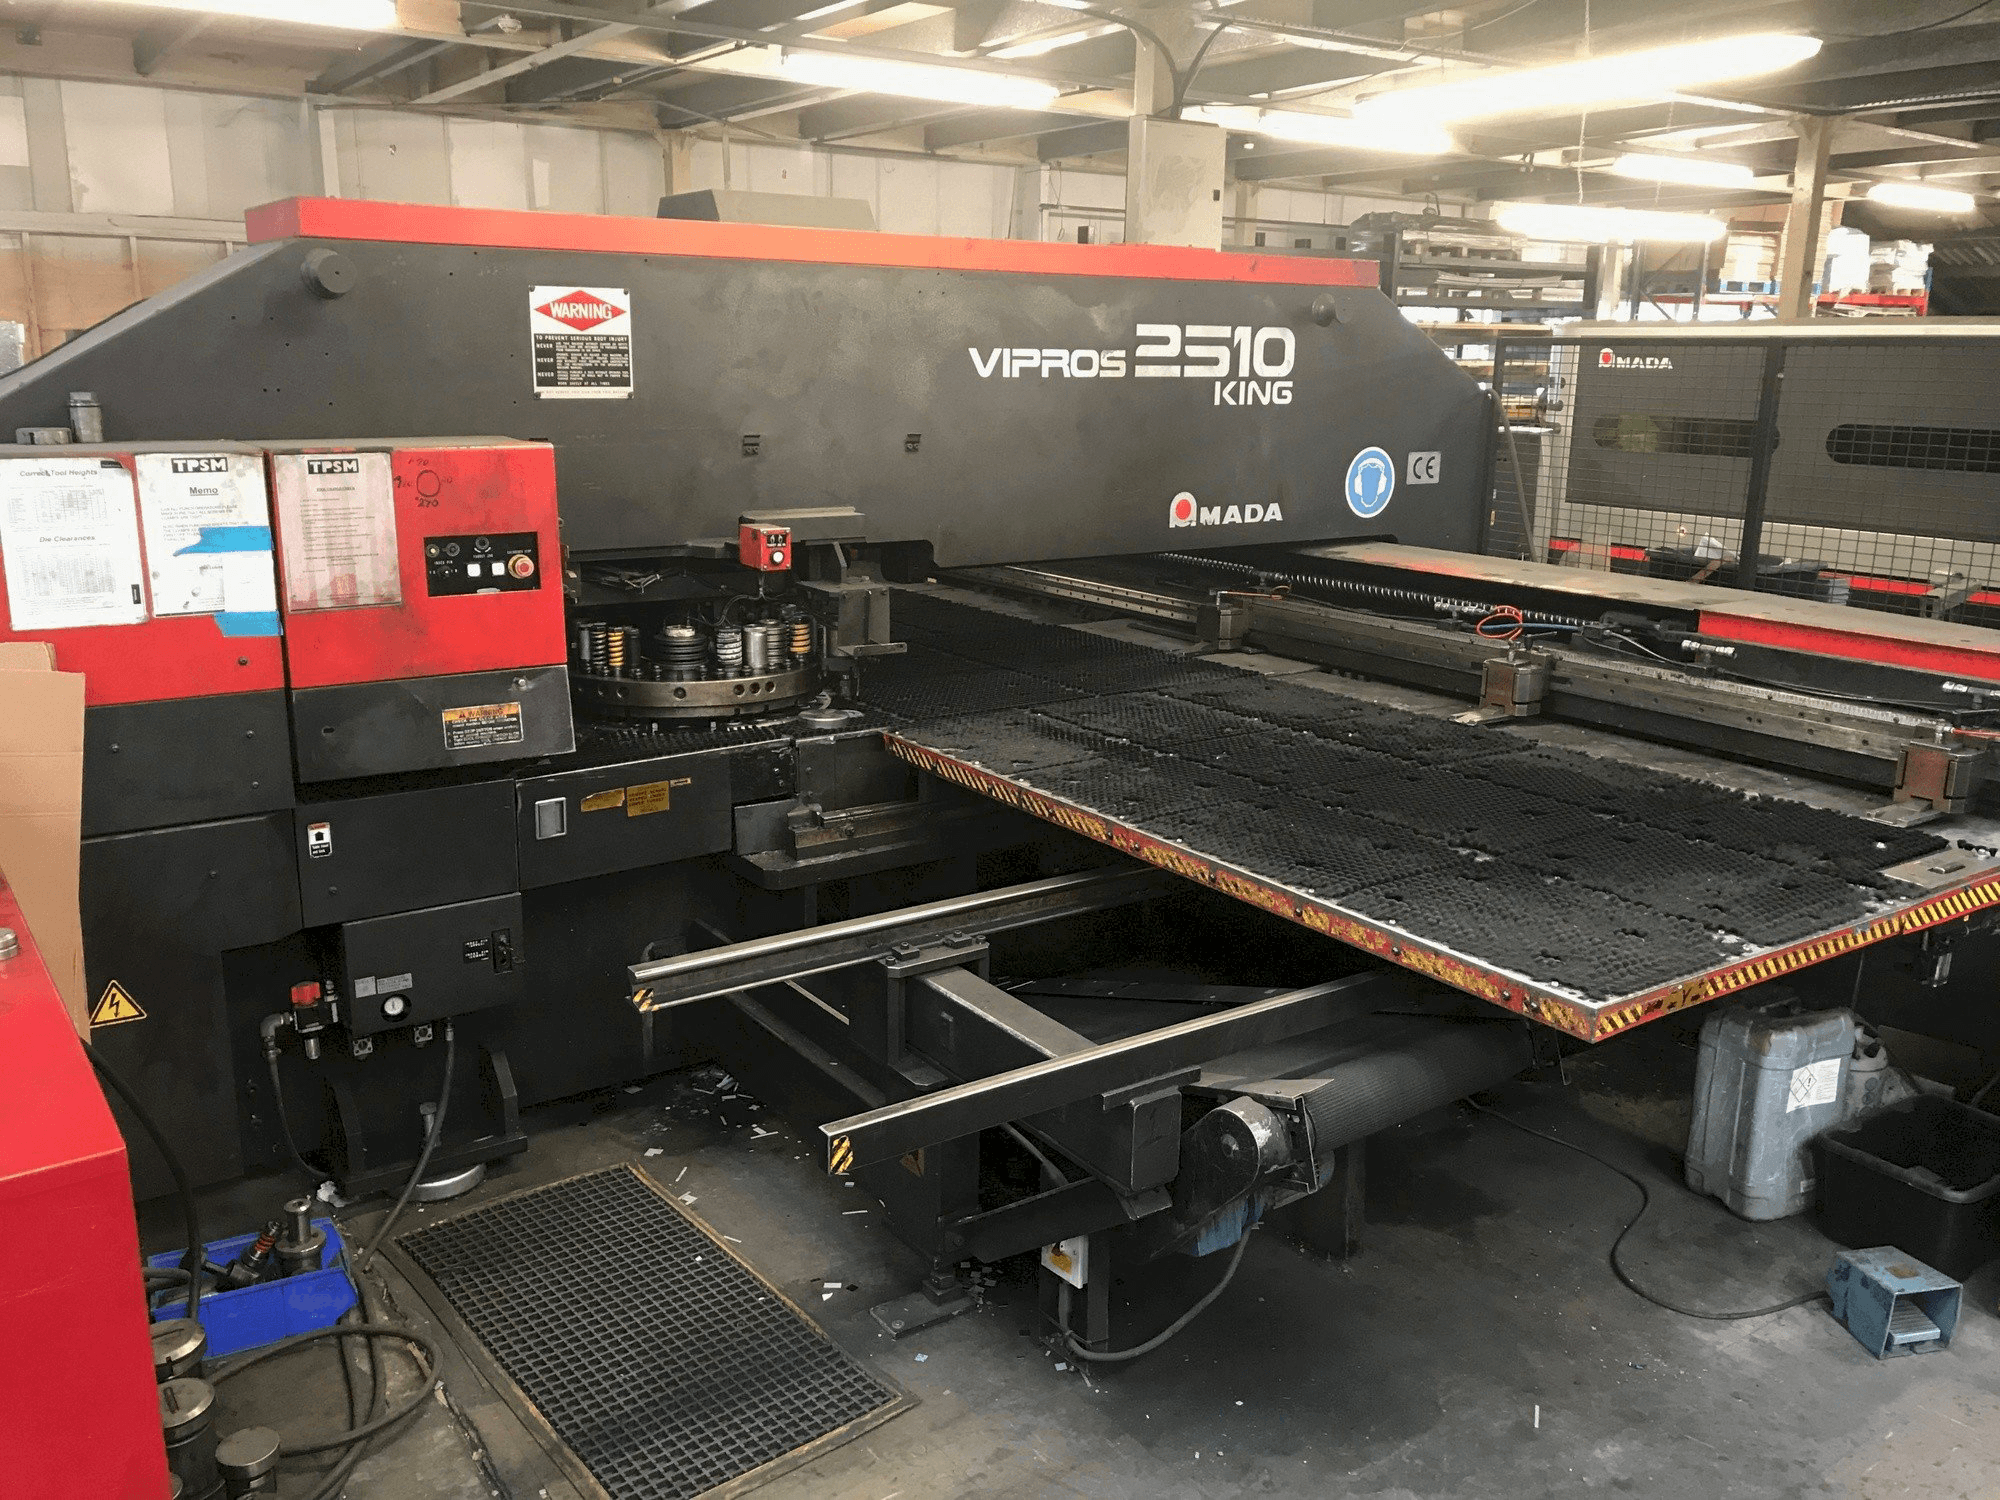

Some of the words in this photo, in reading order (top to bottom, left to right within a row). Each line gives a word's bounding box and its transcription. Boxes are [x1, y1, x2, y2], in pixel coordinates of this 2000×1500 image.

[549, 302, 612, 319] WARNING
[968, 348, 1126, 378] VIPROS
[1134, 324, 1296, 378] 2510
[1598, 348, 1673, 369] AMADA
[1213, 381, 1293, 405] KING
[173, 458, 227, 472] TPSM
[310, 460, 358, 473] TPSM
[1413, 456, 1435, 479] CE
[189, 487, 219, 495] Memo
[1169, 492, 1283, 528] AMADA
